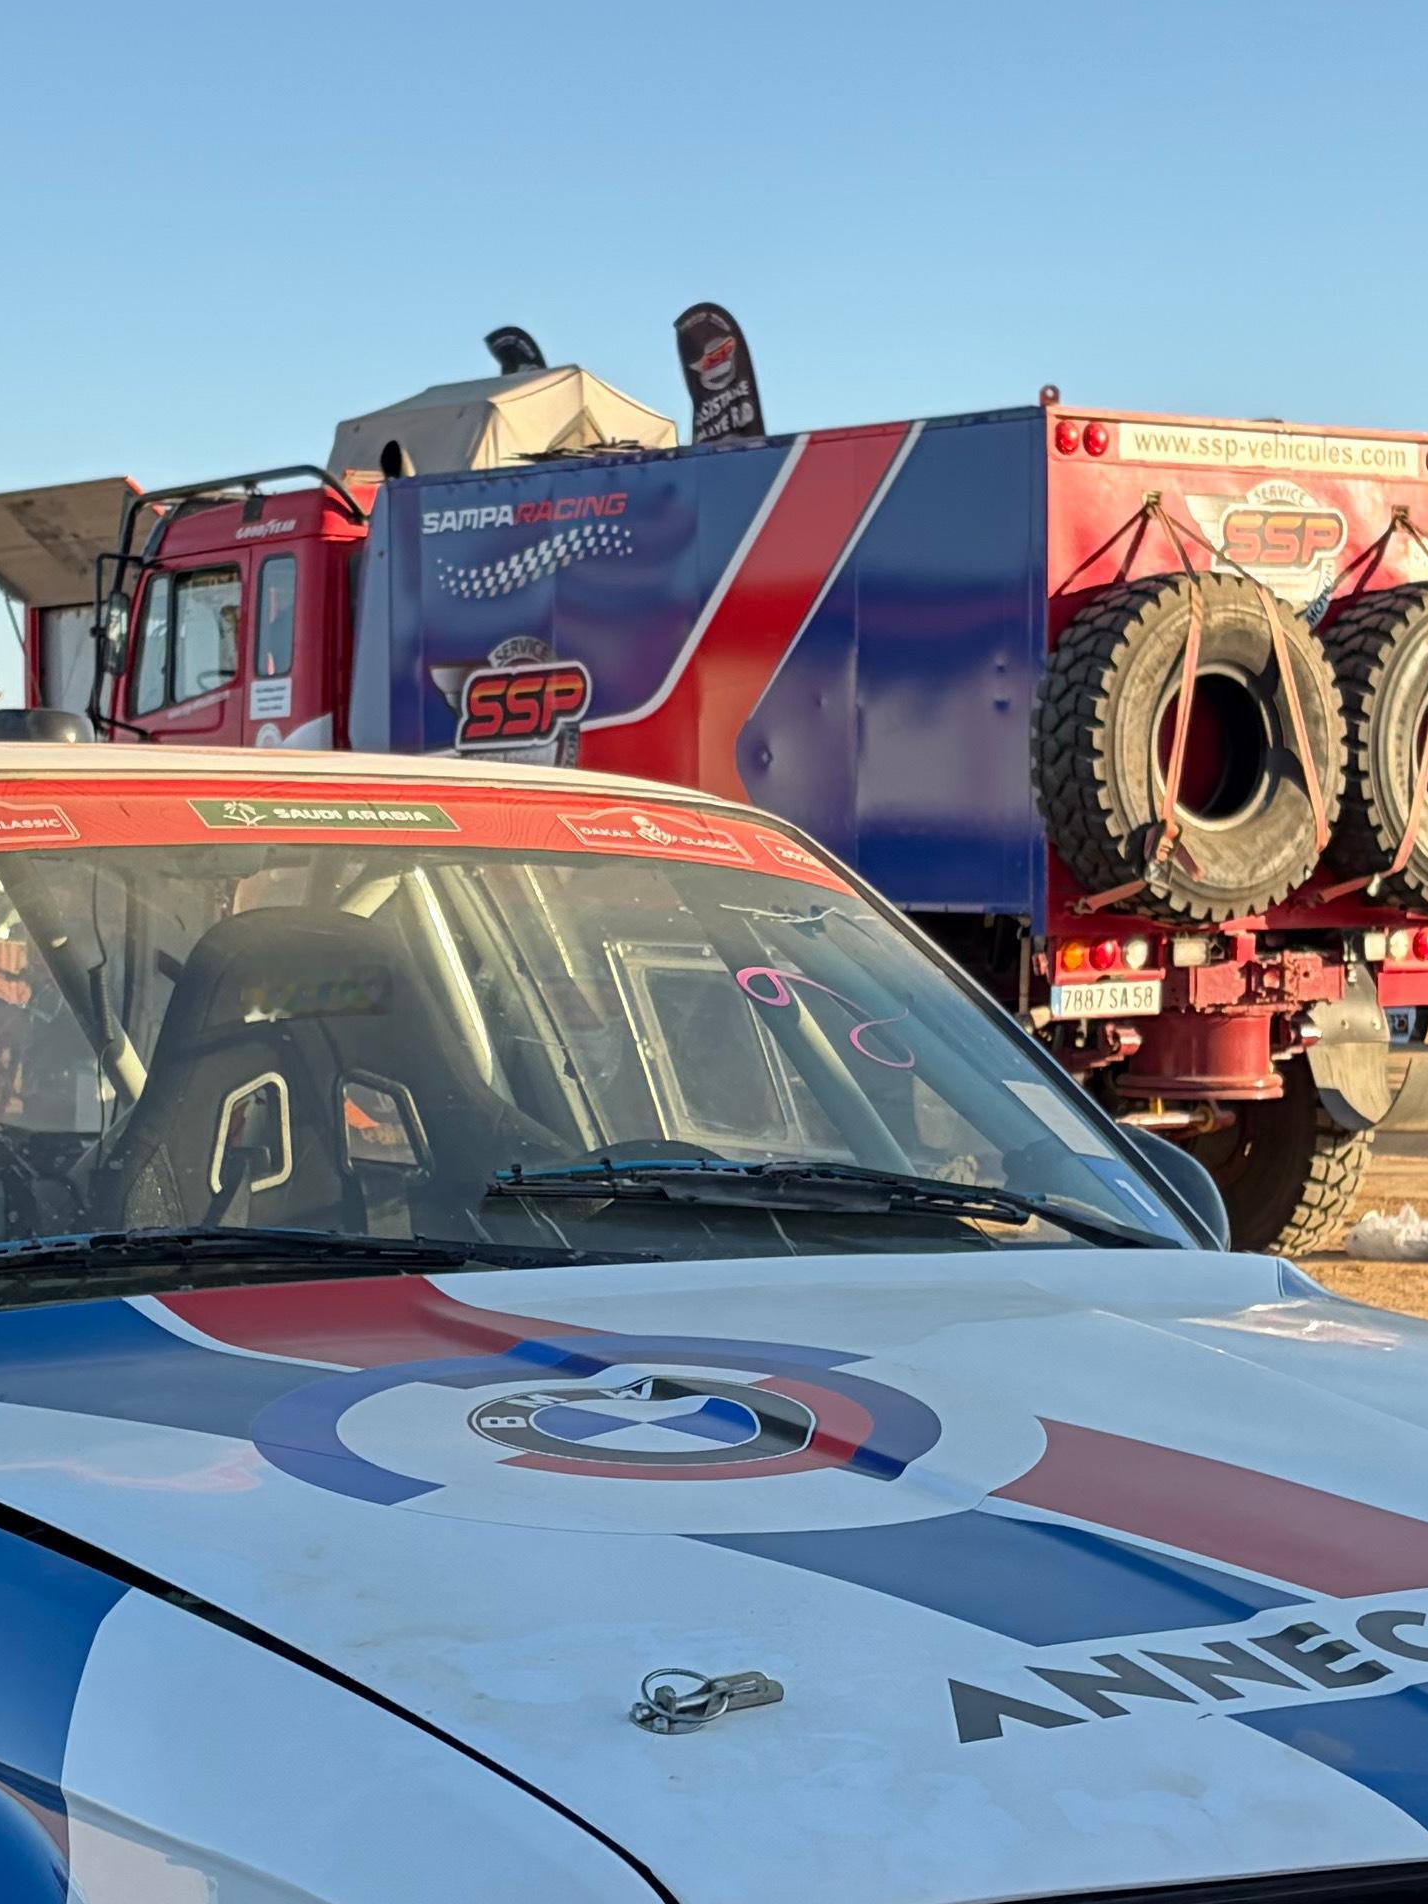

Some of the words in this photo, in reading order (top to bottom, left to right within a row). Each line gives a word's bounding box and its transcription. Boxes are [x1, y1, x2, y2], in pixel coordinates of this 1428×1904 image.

[1134, 432, 1407, 468] www.ssp-vehicules.com
[1253, 487, 1308, 507] SERVICE
[1224, 513, 1341, 564] SSP
[494, 638, 550, 663] SERVICE
[465, 672, 584, 738] SSP
[273, 807, 341, 821] SAUDI
[346, 809, 431, 823] ARABIA
[580, 826, 633, 839] DAKAR
[1063, 988, 1105, 1011] 7887
[1109, 987, 1129, 1008] SA
[1132, 985, 1154, 1007] 58
[480, 1378, 654, 1429] BMW
